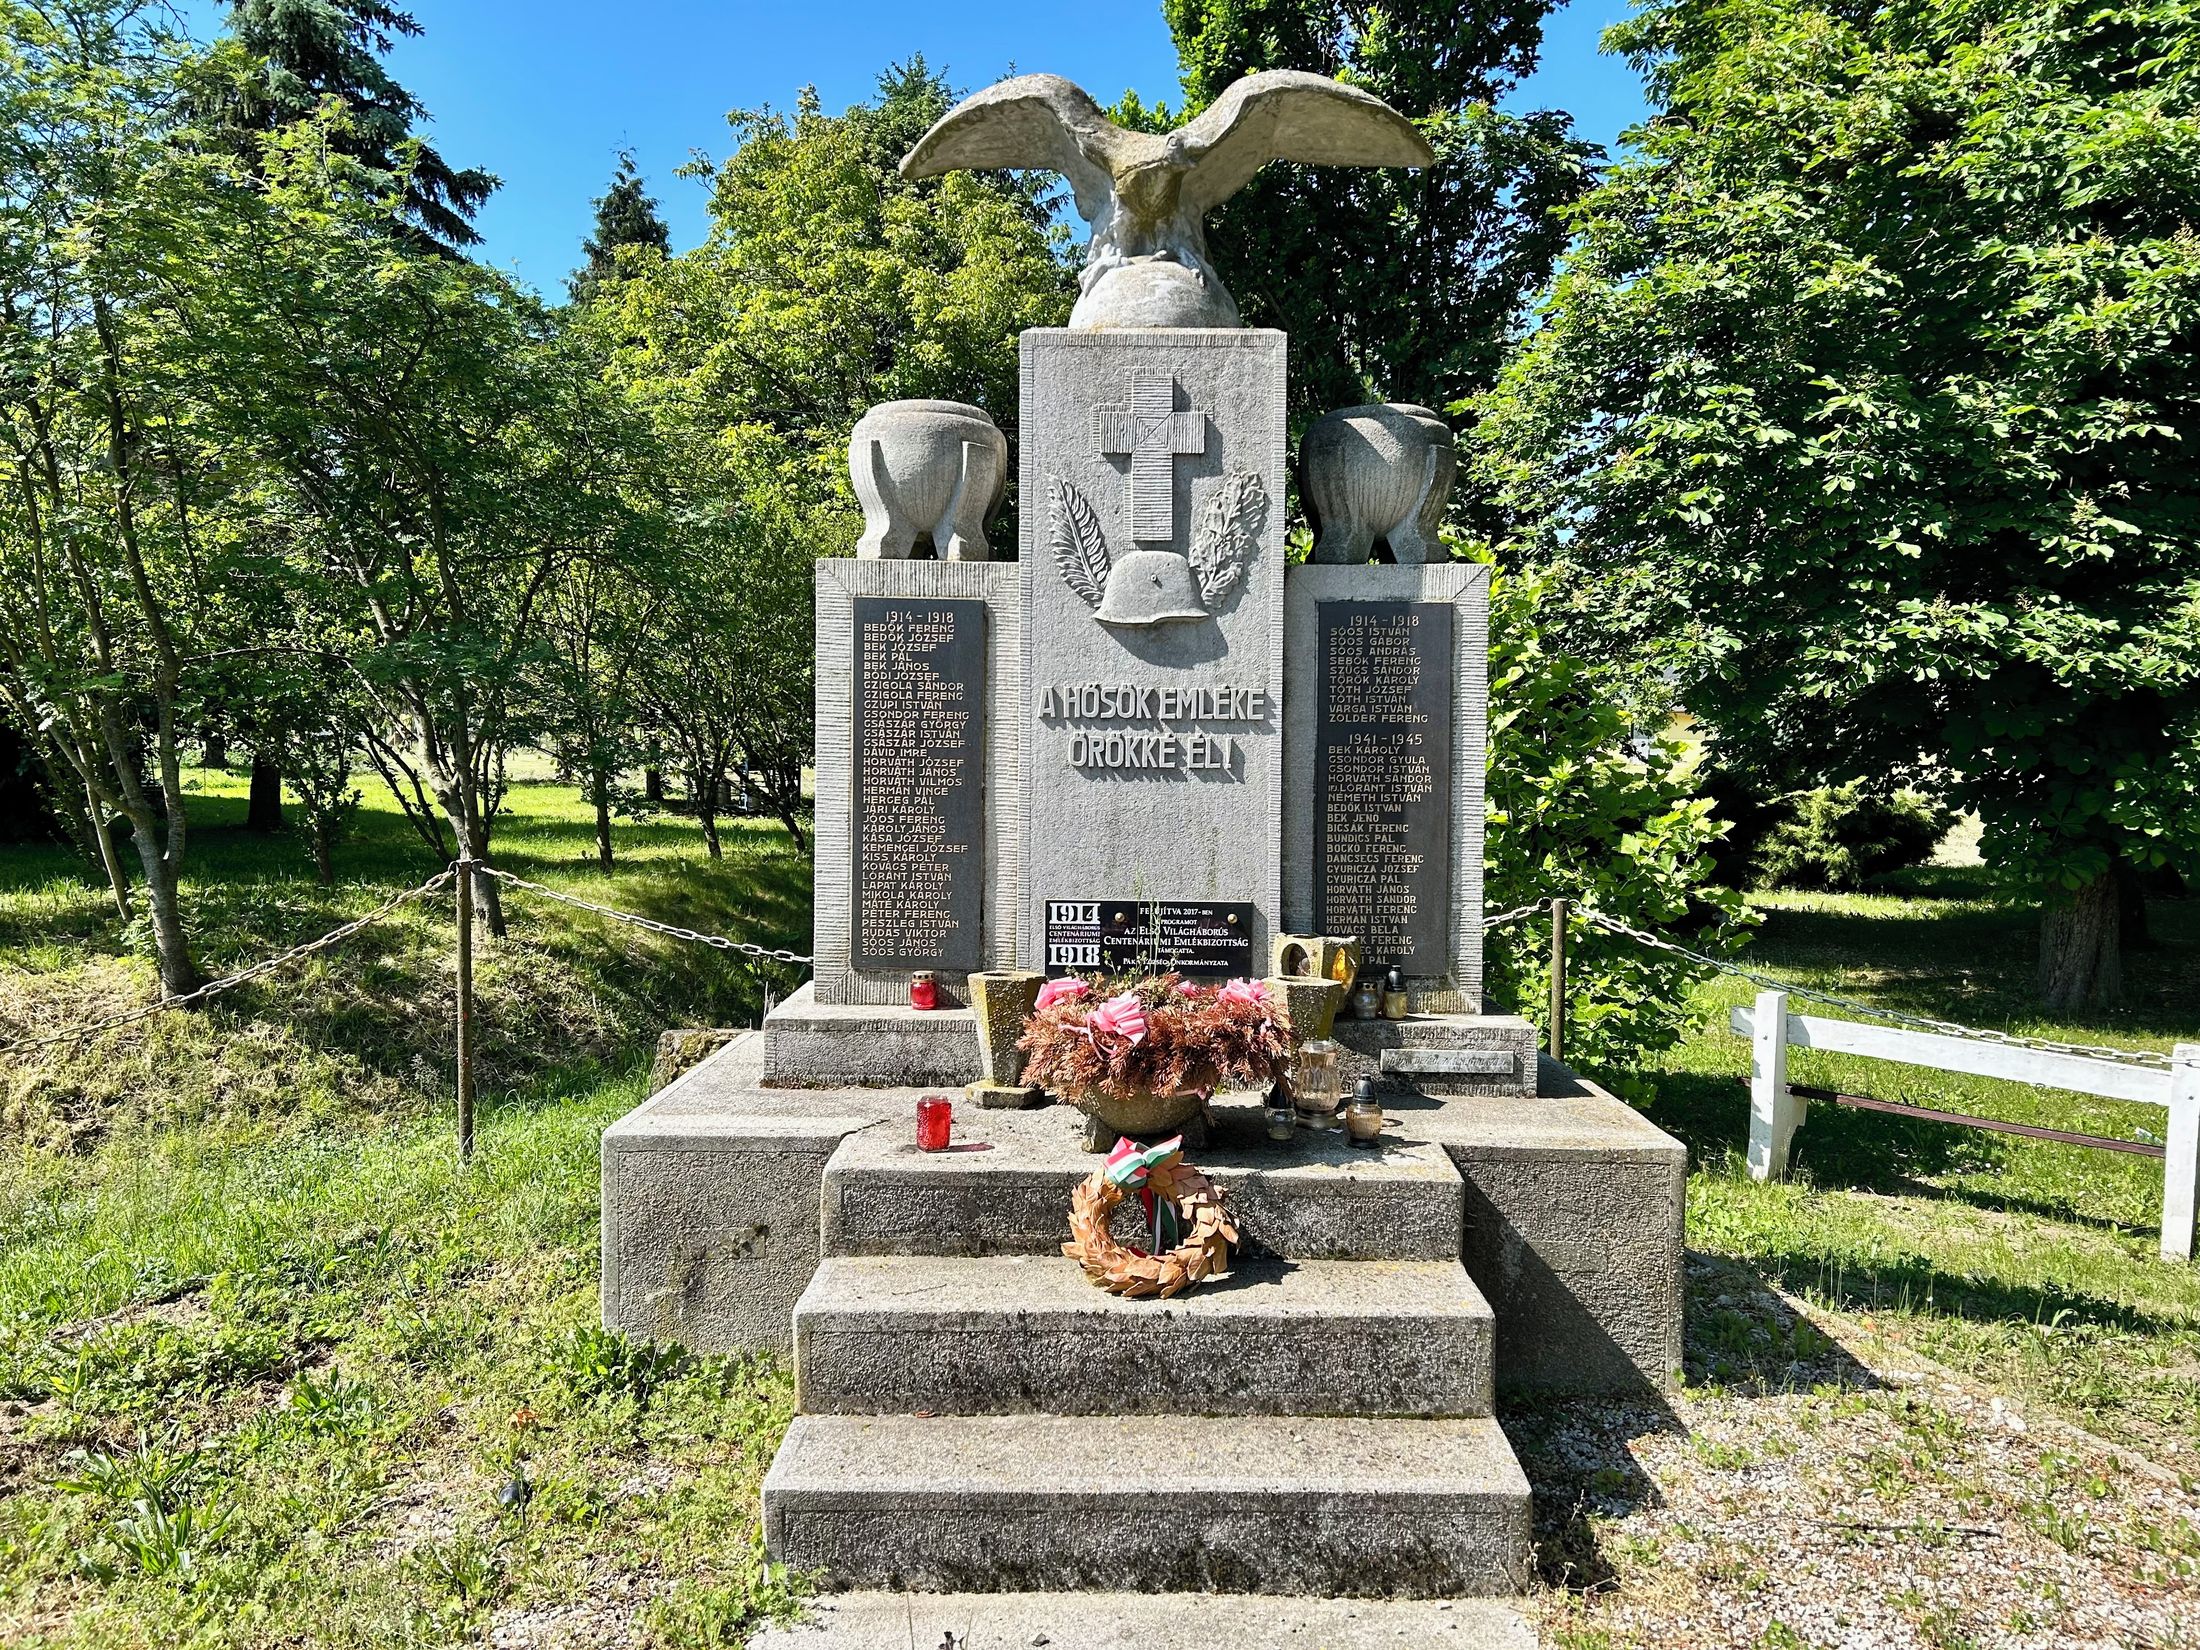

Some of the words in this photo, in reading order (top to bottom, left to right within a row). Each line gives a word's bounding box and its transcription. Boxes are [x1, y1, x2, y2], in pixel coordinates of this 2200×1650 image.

[886, 611, 912, 622] 1914
[928, 612, 954, 623] 1918
[1350, 615, 1377, 626] 1914
[1392, 615, 1419, 626] 1918
[863, 642, 887, 651] BEK
[863, 652, 887, 660] BEK
[863, 662, 887, 670] BEK
[1039, 686, 1056, 718] A
[1064, 683, 1151, 719] HŐSÖK
[1159, 685, 1265, 720] EMLÉKE
[1329, 704, 1366, 713] VARGA
[1349, 734, 1376, 745] 1941
[1392, 734, 1423, 745] 1945
[900, 749, 927, 757] IMRE
[1068, 732, 1176, 768] ÖRÖKKÉ
[1187, 734, 1233, 769] ÉL!
[1328, 745, 1351, 754] BEK
[1389, 755, 1426, 764] GYULA
[919, 777, 963, 786] VILMOS
[1327, 813, 1348, 822] BEK
[862, 853, 888, 861] KISS
[862, 891, 904, 899] MIKOLA
[862, 898, 892, 908] MÁTÉ
[1049, 903, 1100, 924] 1914
[861, 928, 900, 937] RUDAS
[905, 929, 947, 937] VIKTOR
[1124, 927, 1136, 935] AZ
[1174, 936, 1249, 946] EMLÉKBIZOTTSÁG
[1049, 944, 1100, 965] 1918
